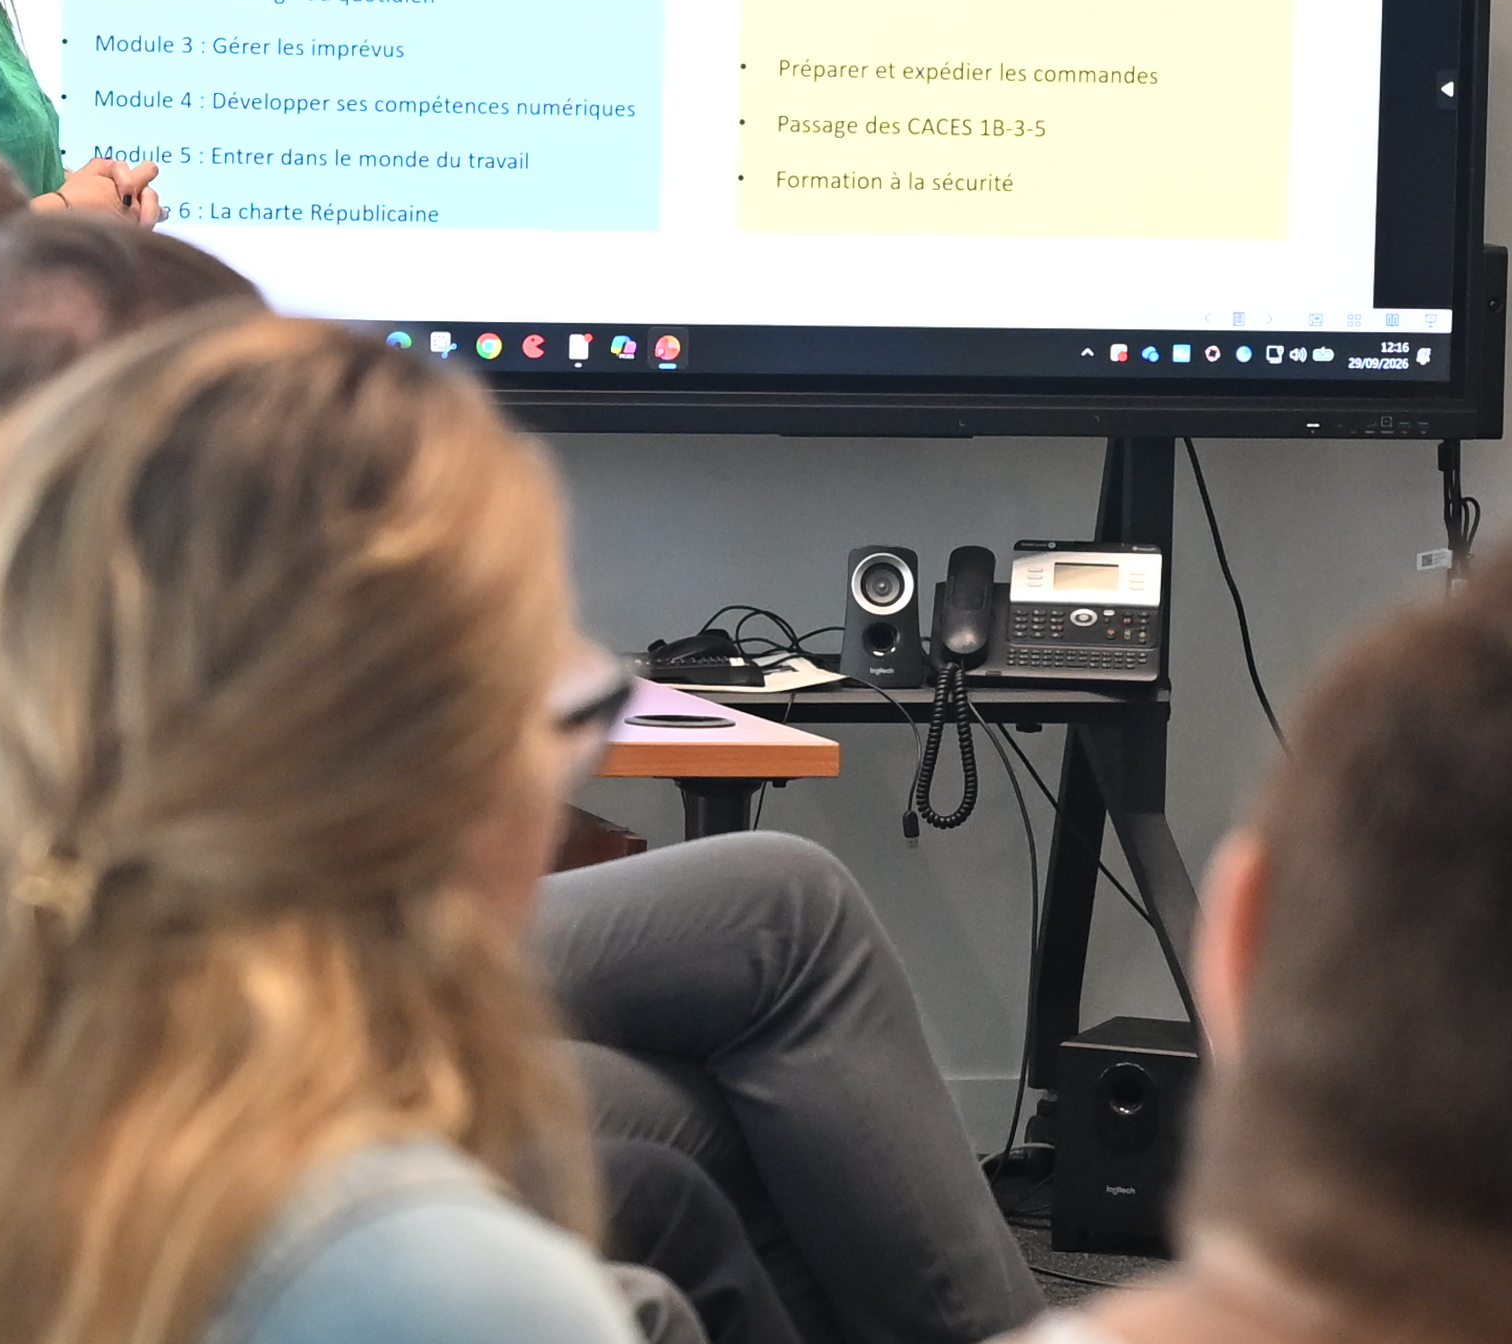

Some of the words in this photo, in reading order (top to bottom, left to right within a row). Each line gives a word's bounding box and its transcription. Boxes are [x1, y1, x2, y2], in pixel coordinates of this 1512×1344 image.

[95, 34, 175, 54] Module
[182, 36, 193, 54] 3
[212, 35, 271, 55] Gérer
[277, 37, 305, 56] les
[311, 38, 405, 61] imprévus
[779, 58, 869, 83] Préparer
[875, 63, 896, 79] et
[902, 61, 993, 85] expédier
[1000, 62, 1027, 82] les
[1033, 65, 1158, 85] commandes
[94, 89, 174, 109] Module
[180, 91, 192, 109] 4
[213, 91, 331, 115] Développer
[336, 98, 368, 112] ses
[374, 95, 510, 118] compétences
[516, 97, 636, 121] numériques
[778, 115, 858, 139] Passage
[865, 115, 901, 135] des
[907, 117, 973, 136] CACES
[980, 119, 1046, 138] 1B-3-5
[180, 146, 191, 164] 5
[211, 147, 274, 166] Entrer
[280, 148, 328, 167] dans
[335, 148, 352, 167] le
[359, 150, 430, 168] monde
[436, 151, 461, 169] du
[468, 152, 529, 170] travail
[776, 170, 882, 190] Formation
[890, 171, 901, 190] à
[908, 171, 925, 191] la
[932, 172, 1014, 192] sécurité
[178, 201, 191, 220] 6
[210, 202, 231, 220] La
[238, 202, 303, 221] charte
[311, 202, 439, 225] Républicaine
[1380, 341, 1410, 354] 12:16
